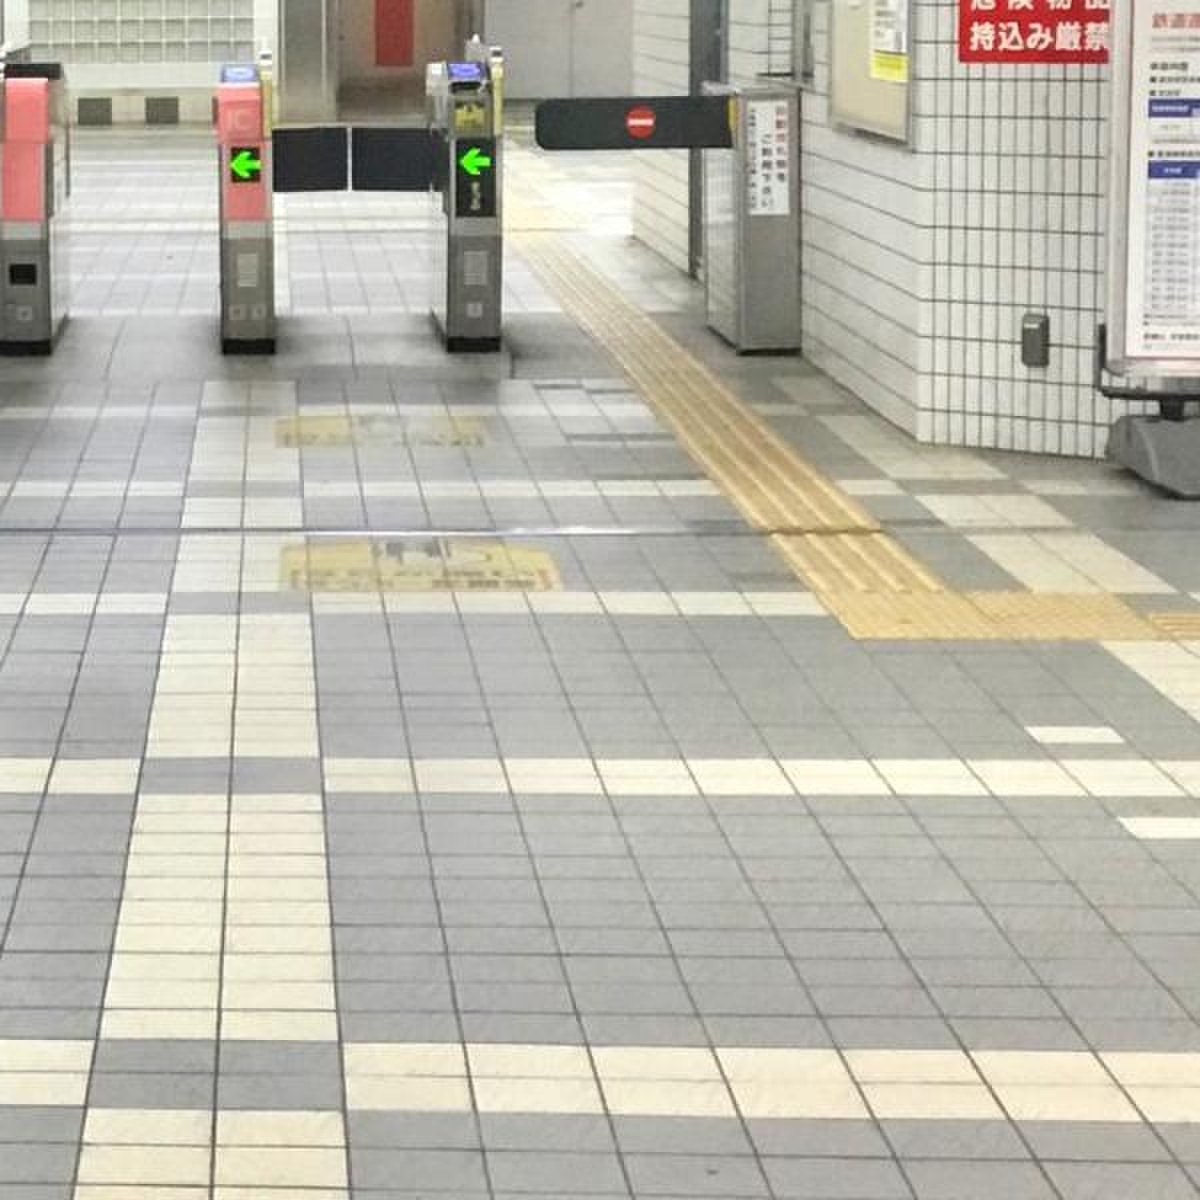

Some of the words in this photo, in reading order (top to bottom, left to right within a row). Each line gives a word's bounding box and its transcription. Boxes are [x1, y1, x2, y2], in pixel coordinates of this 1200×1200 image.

[969, 21, 1109, 51] 持込み厳禁
[226, 109, 255, 132] IC
